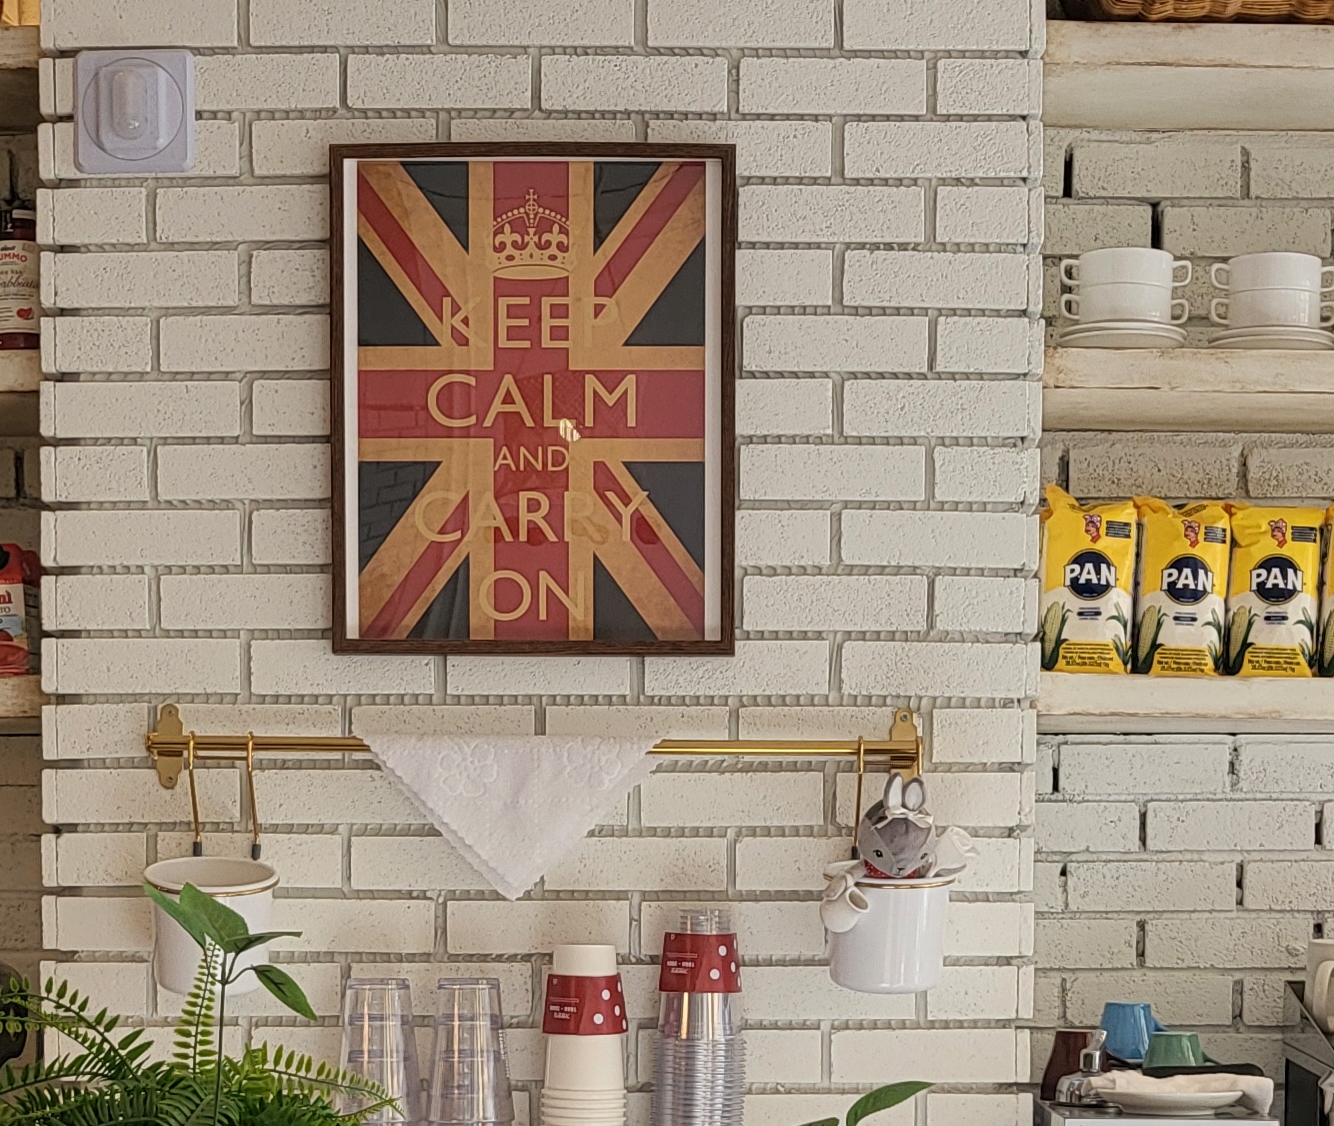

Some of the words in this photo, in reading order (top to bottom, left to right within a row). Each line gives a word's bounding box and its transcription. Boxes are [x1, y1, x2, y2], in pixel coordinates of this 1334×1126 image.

[441, 296, 619, 349] KEEP
[427, 373, 637, 428] CALM
[493, 446, 570, 472] AND
[413, 490, 649, 543] CARRY
[478, 570, 586, 622] ON
